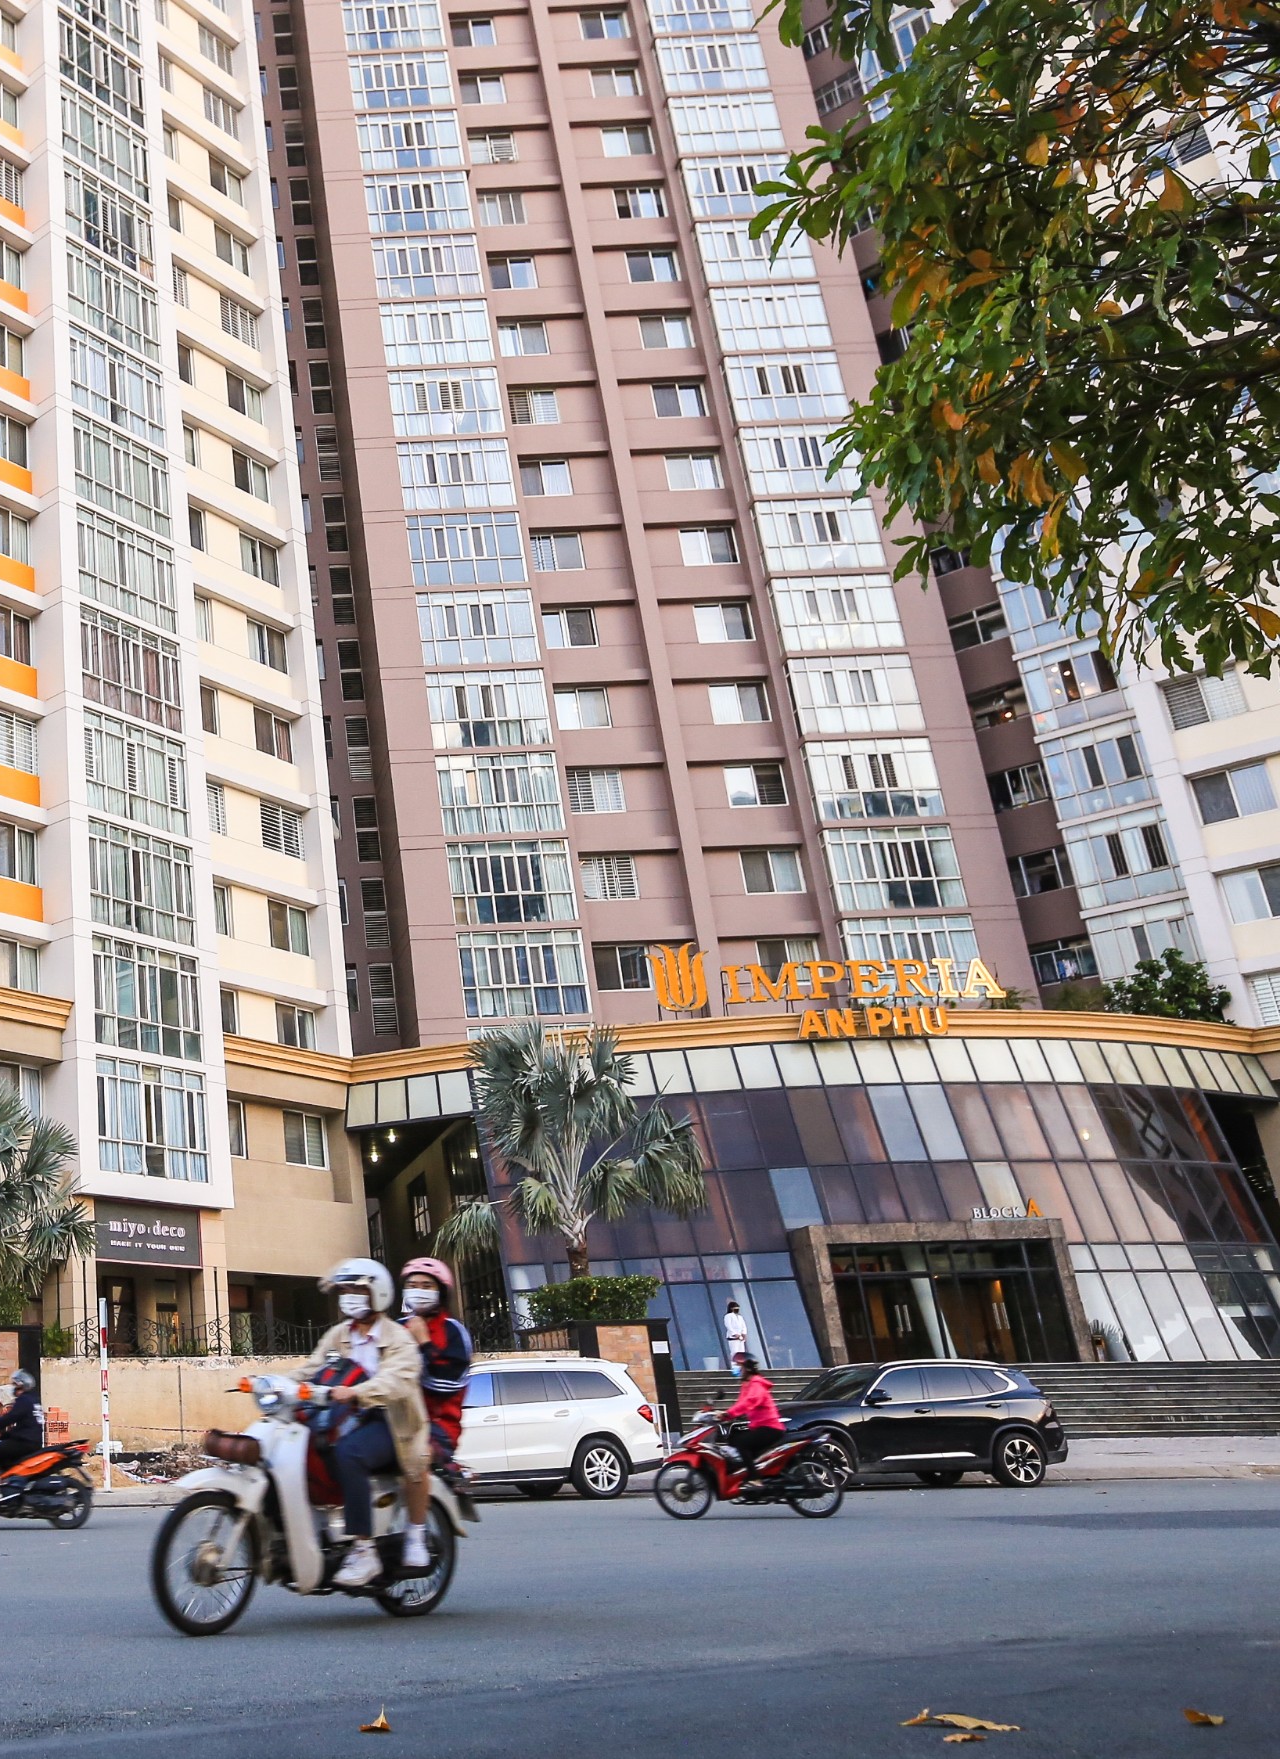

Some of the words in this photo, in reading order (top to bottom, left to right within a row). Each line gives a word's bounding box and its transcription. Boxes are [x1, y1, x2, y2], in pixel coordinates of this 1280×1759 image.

[721, 957, 1007, 1005] IMPERIA
[798, 1008, 857, 1039] AN
[865, 1006, 949, 1036] PHU
[972, 1206, 1026, 1219] BLOCK
[1026, 1198, 1044, 1218] A
[108, 1218, 146, 1238] miyo
[152, 1220, 186, 1238] deco
[110, 1239, 132, 1248] MAKE
[146, 1243, 167, 1251] YOUR
